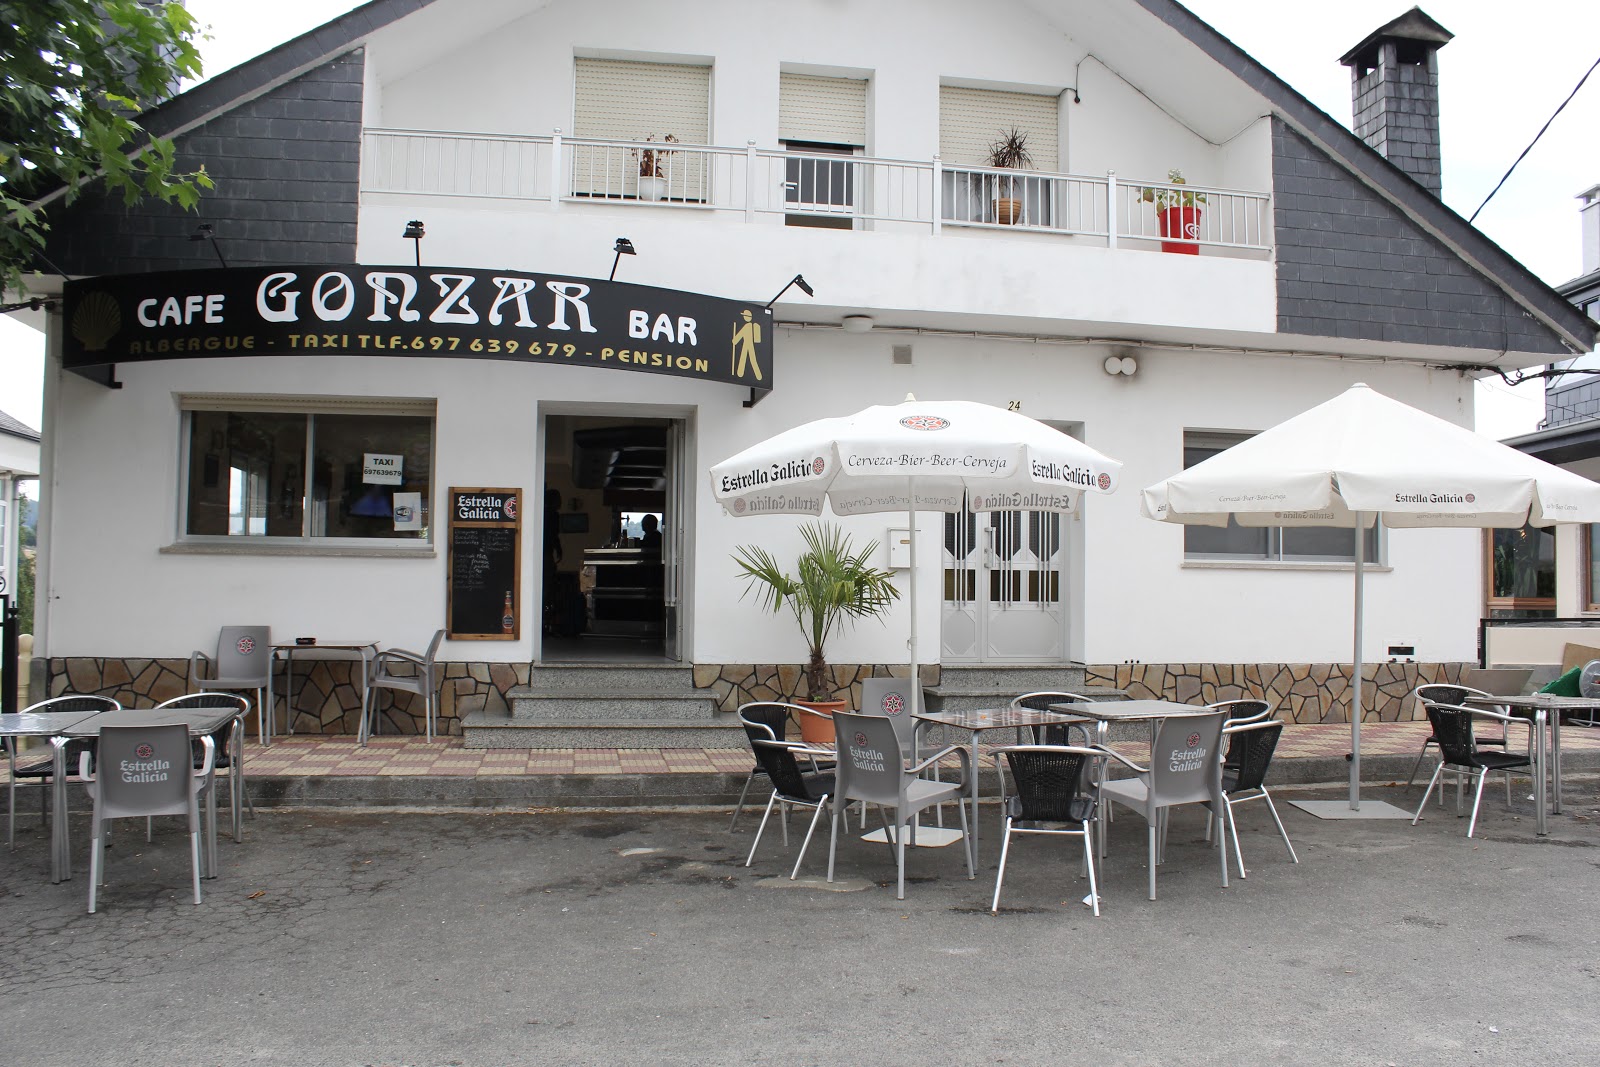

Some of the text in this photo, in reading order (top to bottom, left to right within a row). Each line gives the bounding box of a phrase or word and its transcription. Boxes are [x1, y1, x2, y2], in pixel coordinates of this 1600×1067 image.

[137, 271, 698, 347] CAFE GONZAR BAR
[129, 335, 255, 355] ALBERGUE
[289, 334, 349, 349] TAXI
[470, 338, 520, 354] 639
[528, 341, 577, 357] 679
[601, 347, 709, 373] PENSION
[1007, 400, 1021, 411] 24
[373, 458, 394, 466] TAXI
[721, 468, 769, 492] Estrella
[1062, 464, 1097, 487] Galicia
[457, 495, 502, 508] Estrella
[1395, 493, 1464, 504] Estrella Galicia
[459, 506, 500, 519] Galicia
[849, 745, 884, 761] Estrella
[1169, 747, 1207, 761] Estrella
[120, 760, 170, 772] Estrella
[852, 757, 885, 772] Galicia
[1169, 759, 1203, 772] Galicia
[121, 771, 168, 783] Galicia
